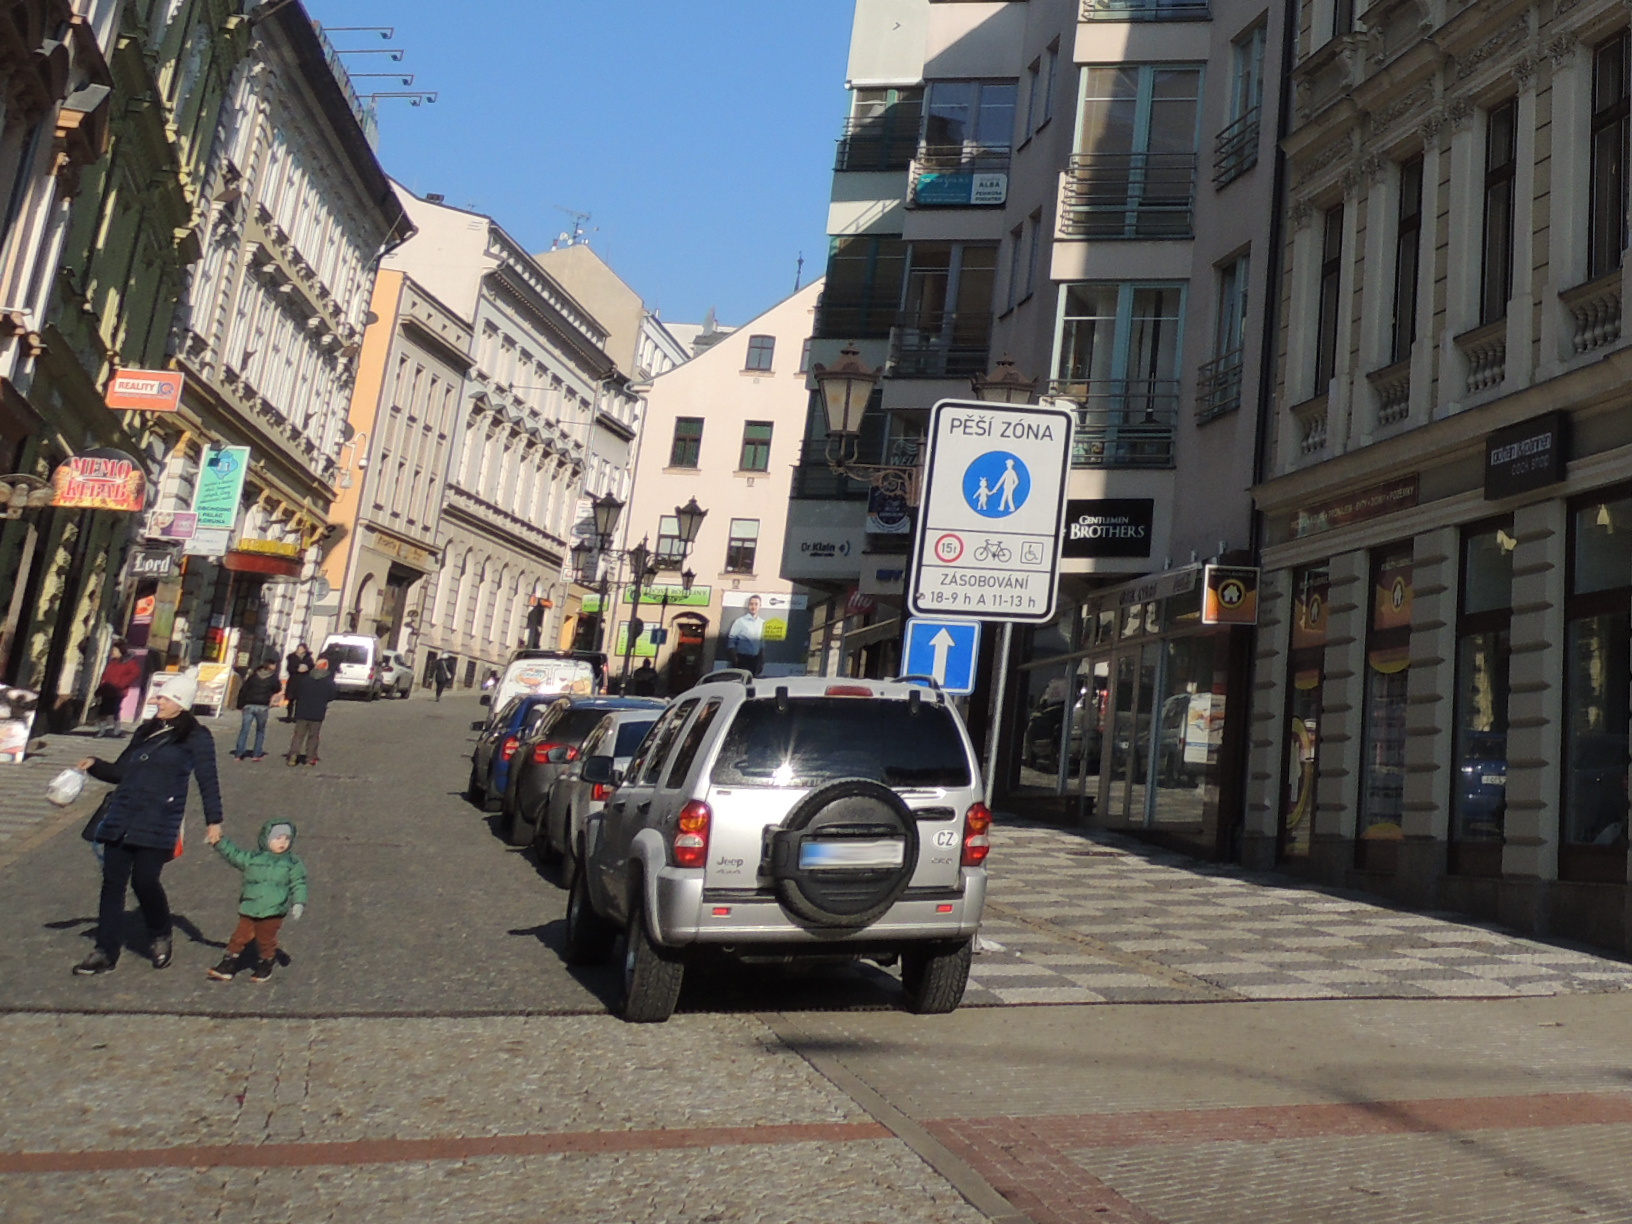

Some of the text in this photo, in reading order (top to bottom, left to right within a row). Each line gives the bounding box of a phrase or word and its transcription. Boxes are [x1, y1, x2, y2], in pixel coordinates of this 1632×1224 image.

[118, 381, 156, 392] REALITY
[950, 414, 1054, 442] PĚŠÍ ZÓNA
[70, 456, 133, 479] MEMO
[1531, 454, 1550, 471] shop
[64, 479, 128, 500] KEBAB
[1079, 515, 1129, 524] GENTLEMEN
[1070, 523, 1144, 540] BROTHERS
[133, 552, 172, 573] Lord
[940, 572, 1030, 590] ZÁSOBOVÁNÍ
[930, 591, 1036, 608] 18-9 h A 11-13 h
[938, 832, 954, 846] CZ
[716, 856, 744, 868] Jeep
